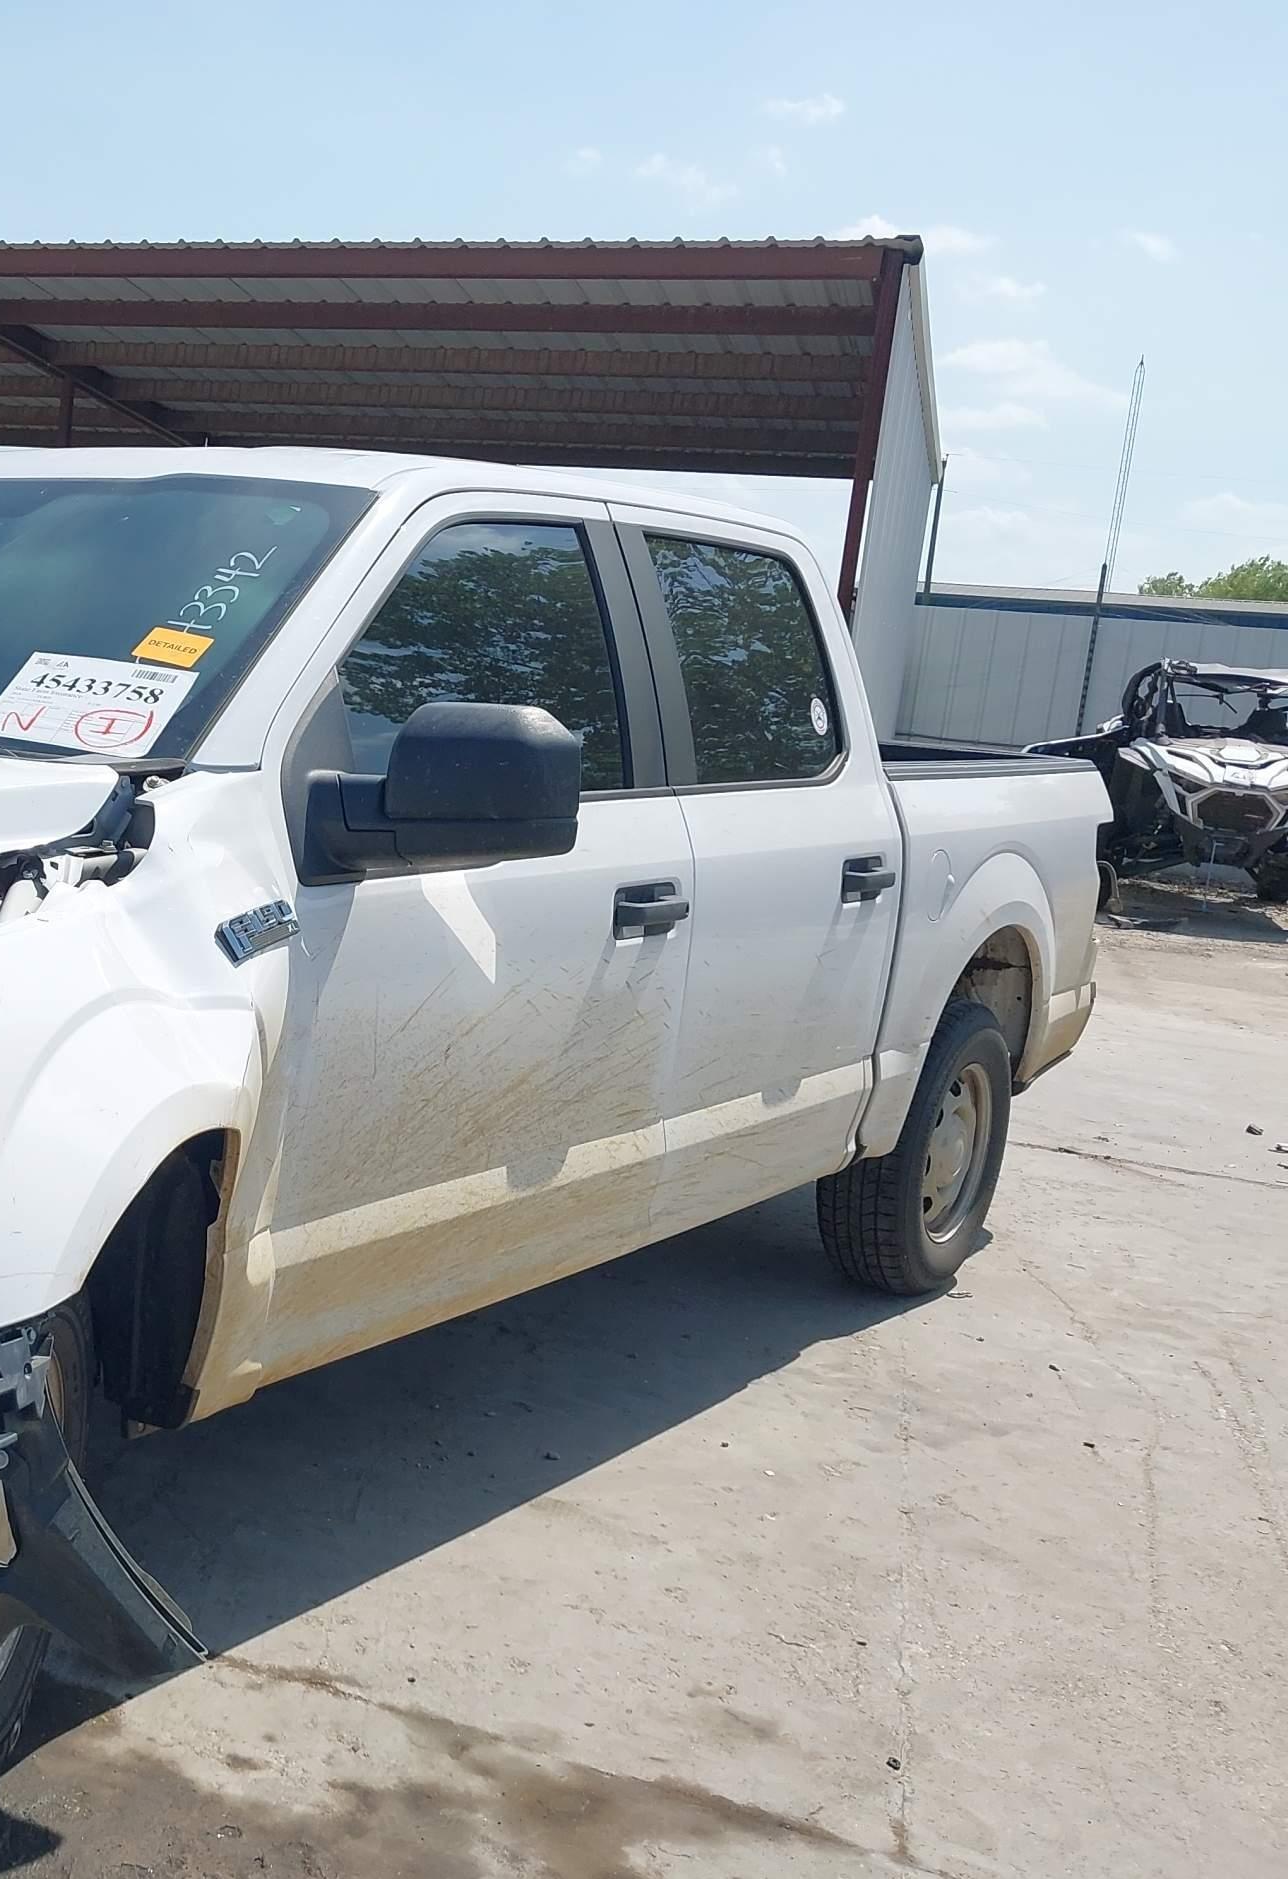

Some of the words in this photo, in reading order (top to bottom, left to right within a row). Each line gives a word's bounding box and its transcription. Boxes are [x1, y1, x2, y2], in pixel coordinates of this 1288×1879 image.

[148, 639, 198, 655] DETAILED
[30, 672, 165, 704] 45433758
[287, 922, 298, 933] XL
